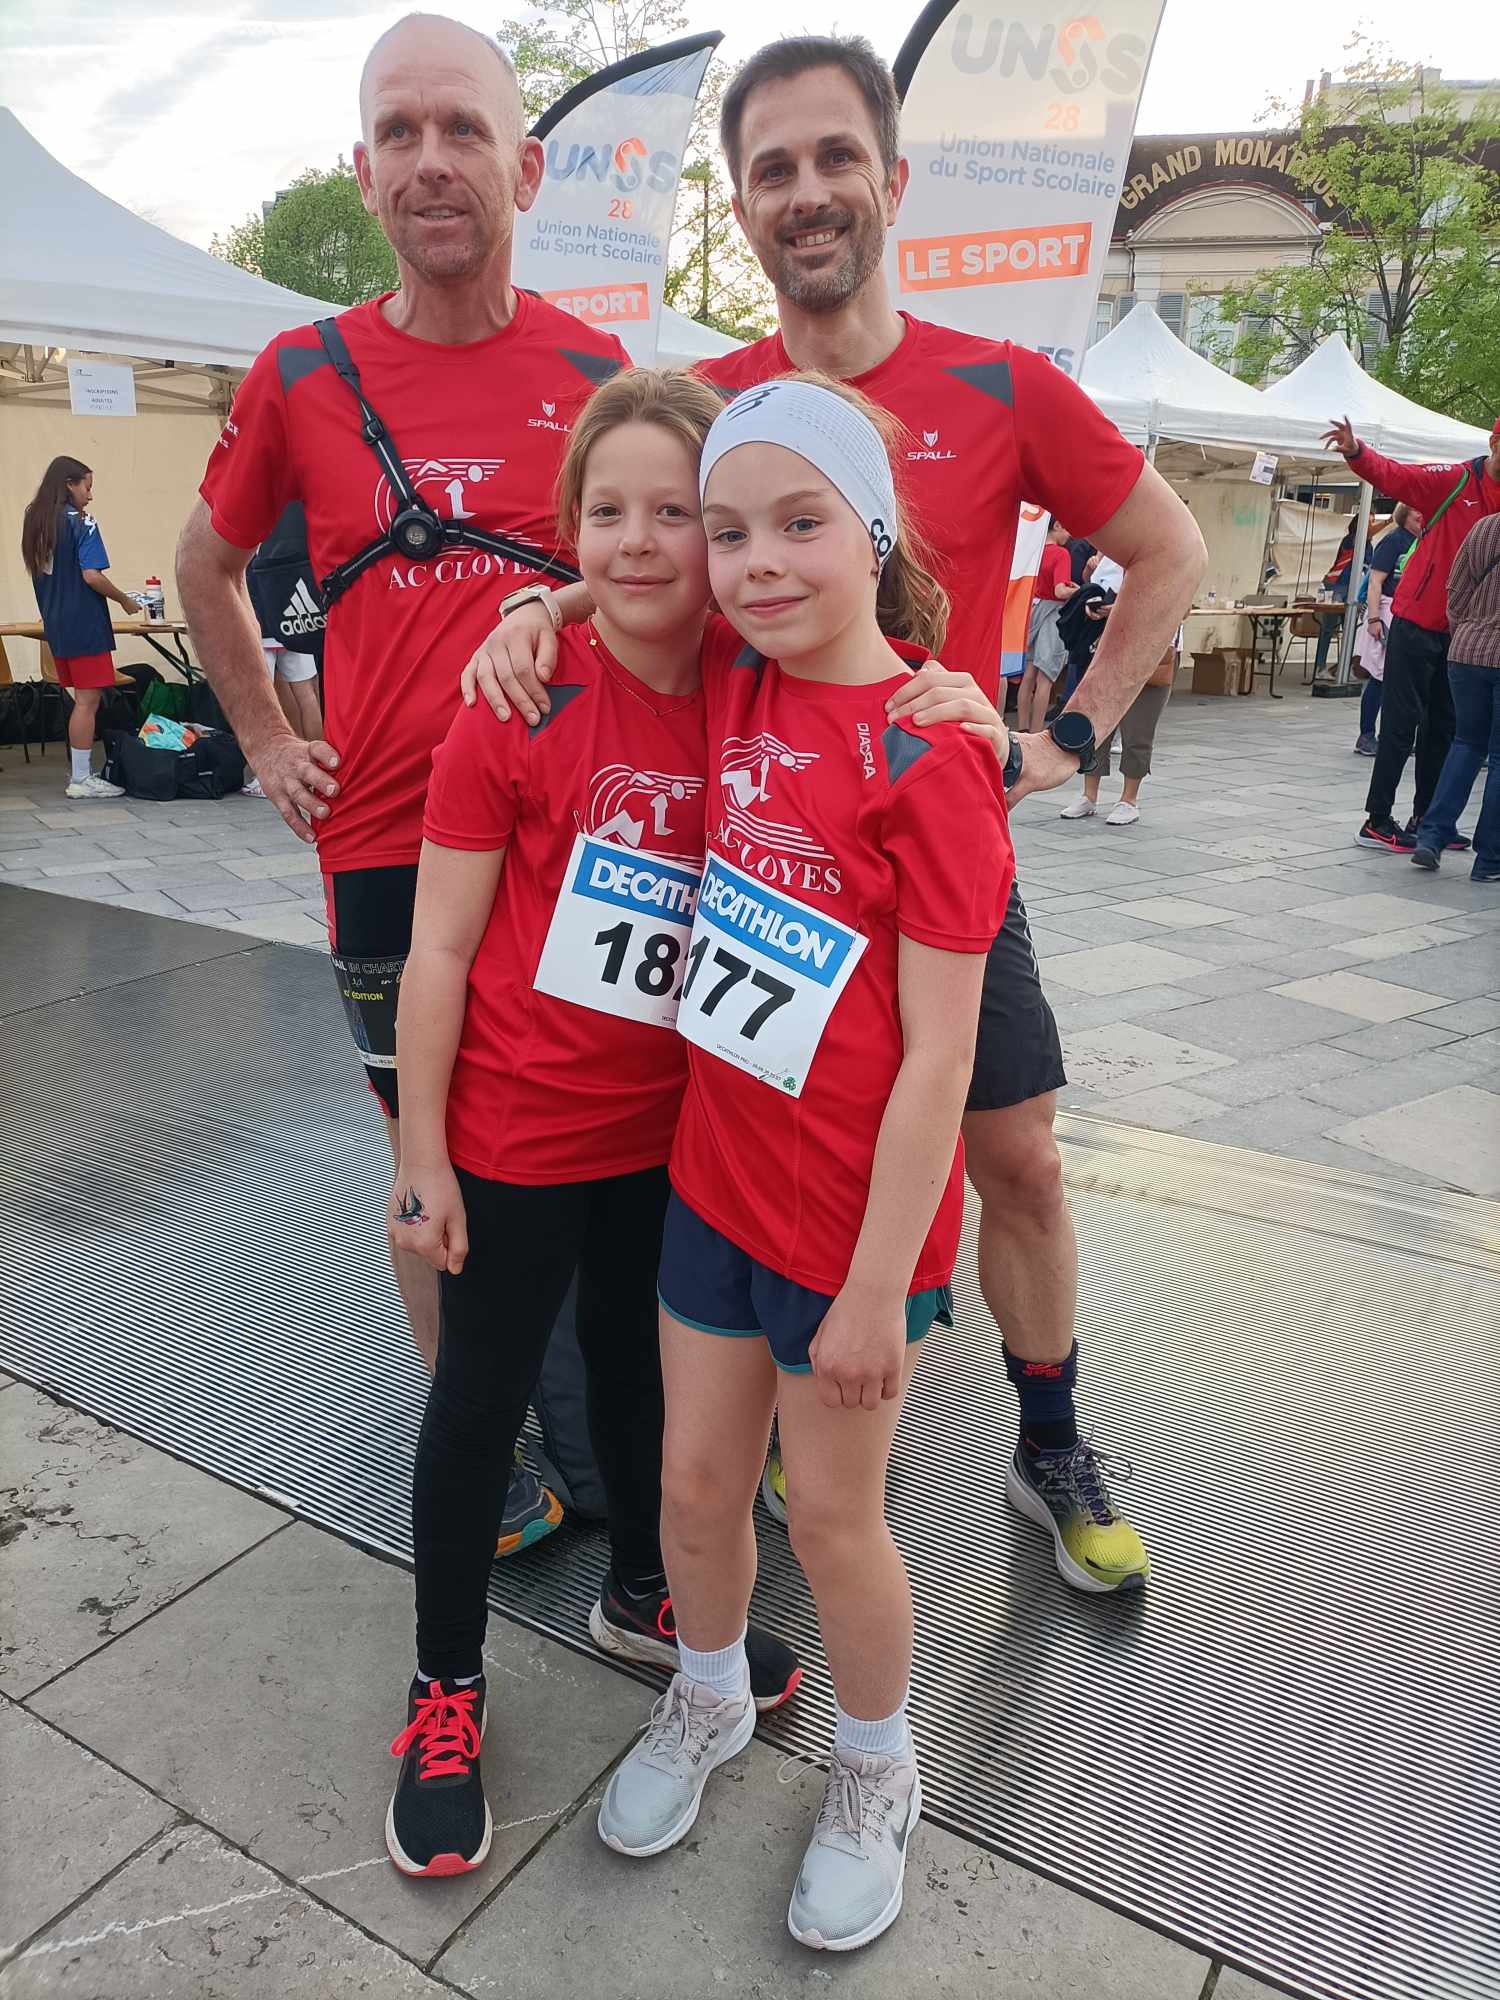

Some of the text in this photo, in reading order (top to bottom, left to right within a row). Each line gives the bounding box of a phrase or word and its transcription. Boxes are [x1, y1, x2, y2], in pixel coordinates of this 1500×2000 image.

[951, 13, 1146, 95] UNSS
[1044, 103, 1080, 132] 28
[546, 137, 678, 193] UNSS
[939, 132, 1116, 174] Union Nationale
[929, 155, 1117, 199] du Sport Scolaire
[1118, 145, 1201, 210] GRAND
[607, 198, 633, 220] 28
[529, 235, 662, 266] du Sport Scolaire
[536, 219, 661, 249] Union Nationale
[904, 234, 1085, 282] LE SPORT
[556, 289, 644, 317] SPORT
[527, 418, 572, 433] SPALL
[905, 450, 957, 461] SPALL
[388, 552, 545, 591] AC CLOYE
[701, 874, 837, 970] DECATHLON
[594, 921, 689, 1002] 18
[682, 935, 796, 1041] 177
